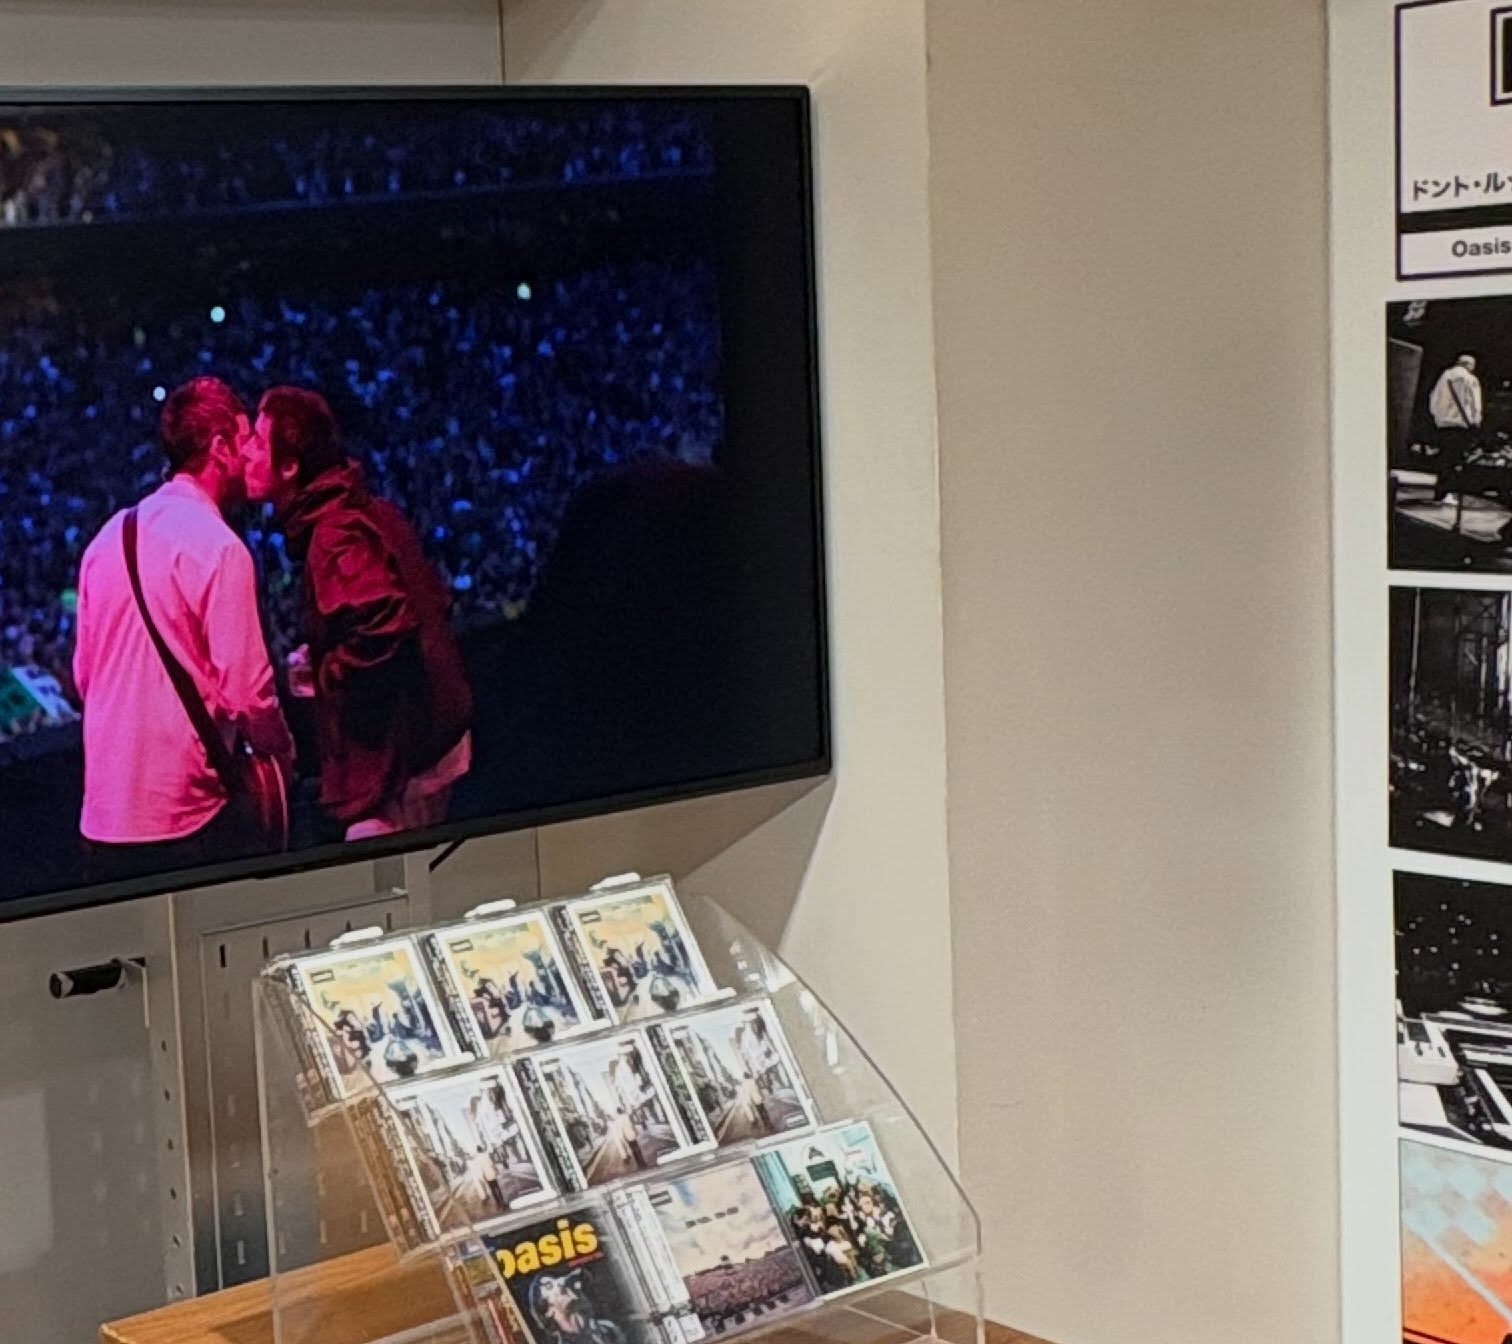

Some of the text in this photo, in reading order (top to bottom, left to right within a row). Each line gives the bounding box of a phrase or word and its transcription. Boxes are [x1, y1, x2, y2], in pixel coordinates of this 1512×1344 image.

[1412, 170, 1512, 202] ドント・ル
[1451, 235, 1512, 258] Oasis
